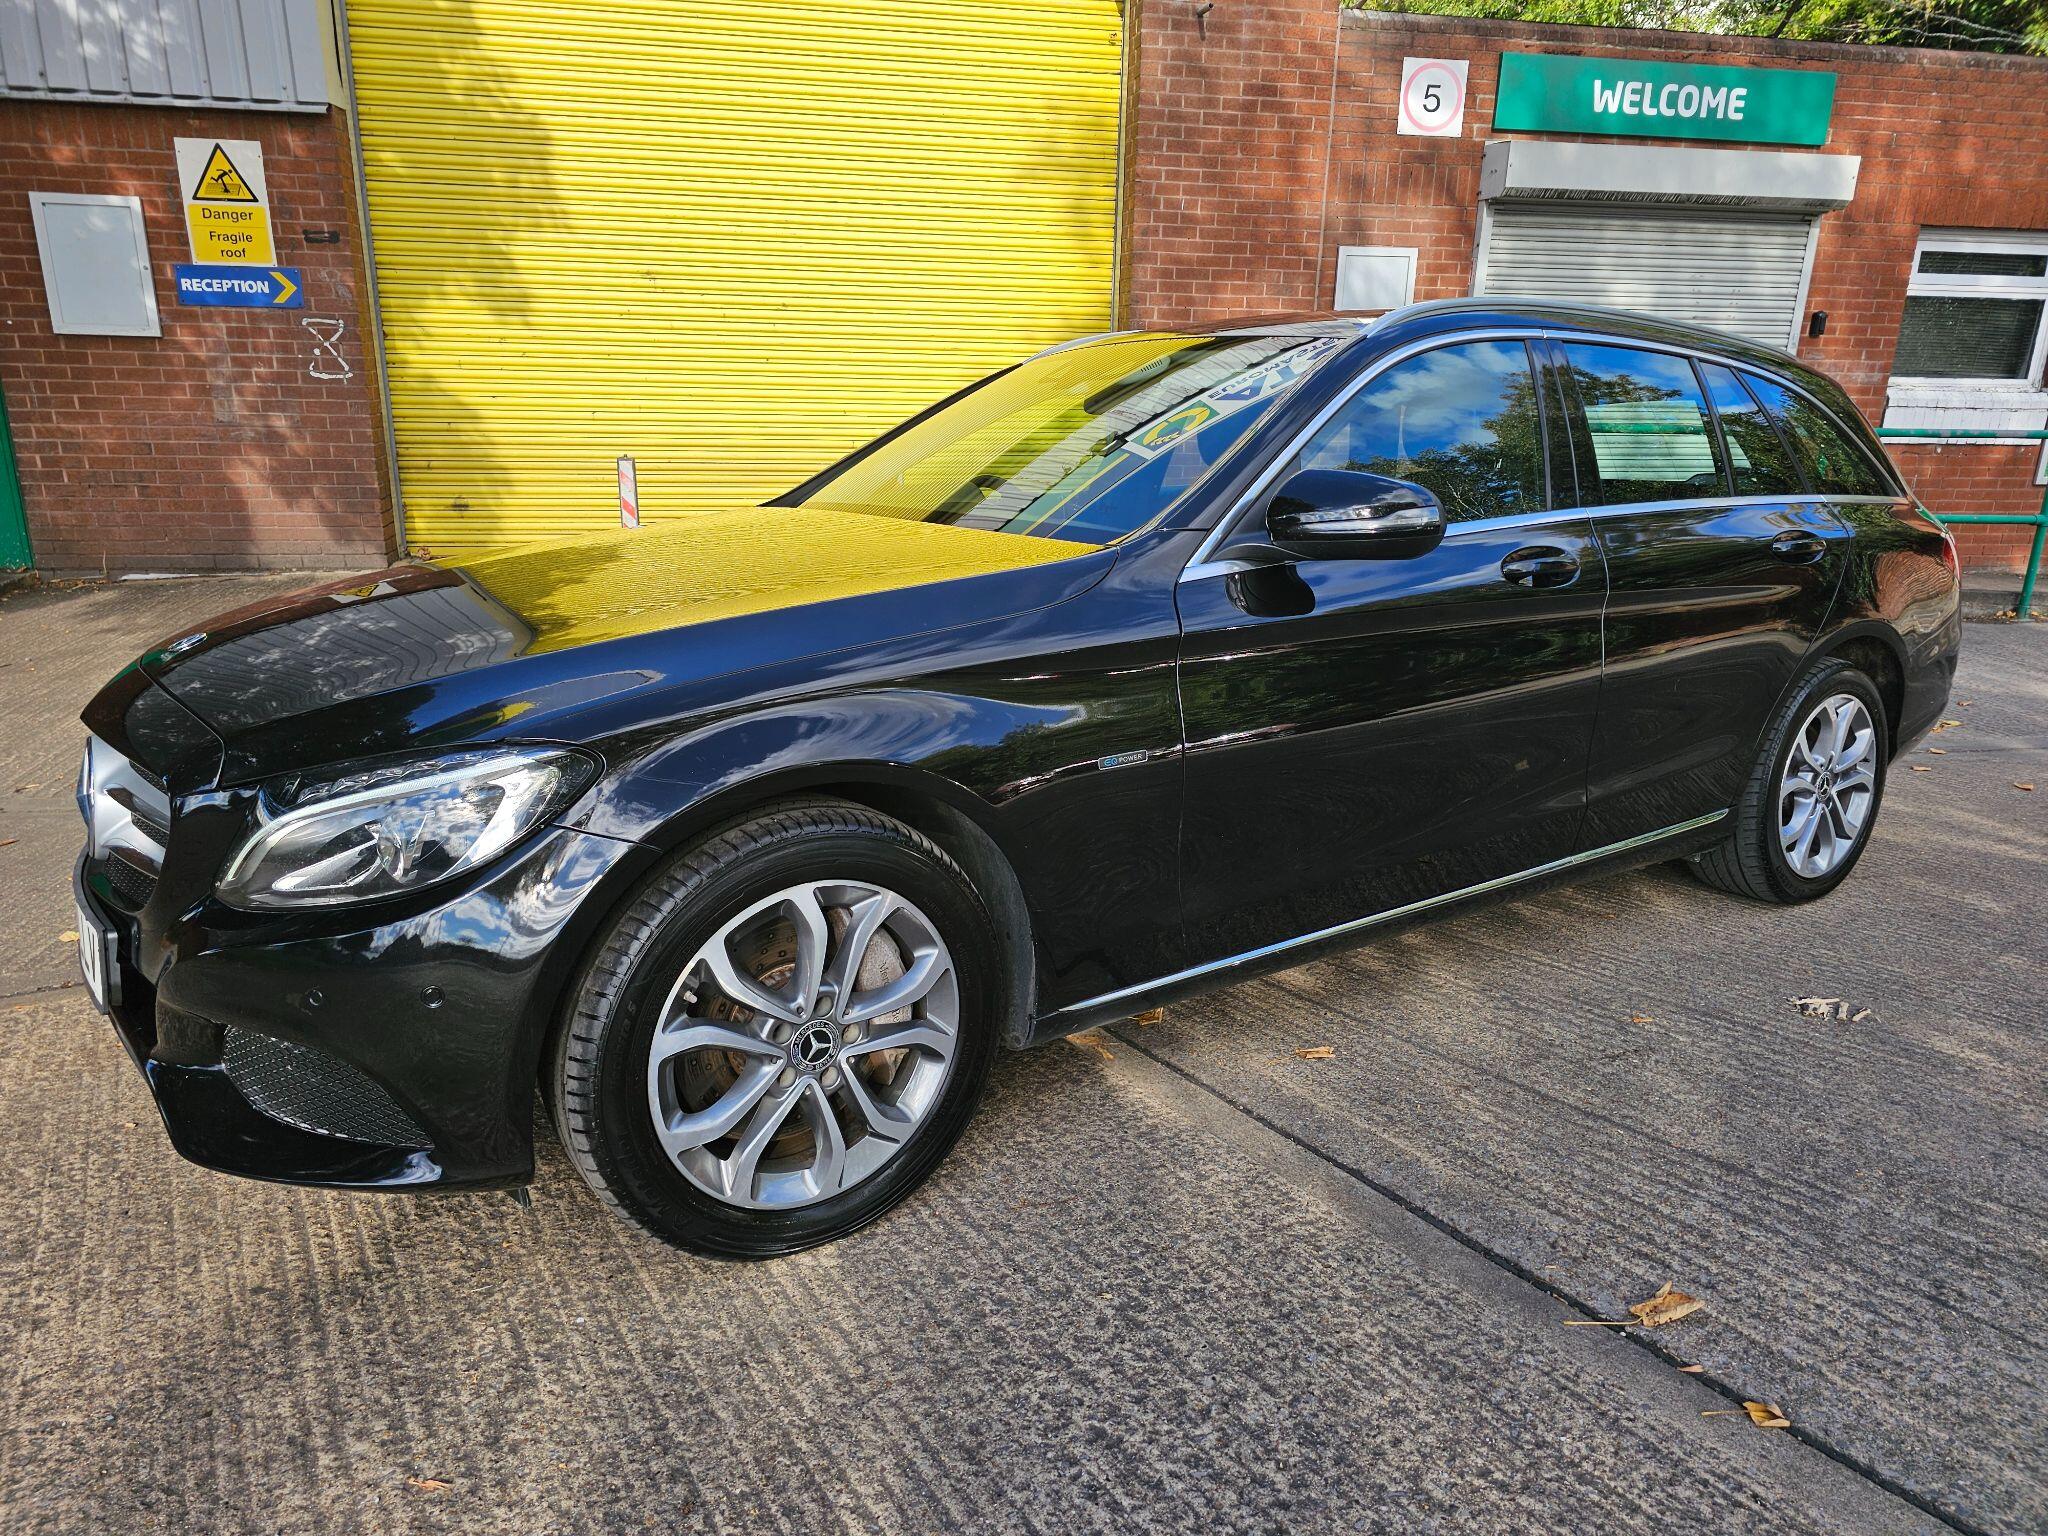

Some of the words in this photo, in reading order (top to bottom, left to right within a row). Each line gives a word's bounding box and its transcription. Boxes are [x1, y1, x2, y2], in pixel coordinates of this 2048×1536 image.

[1422, 84, 1442, 113] 5
[1593, 79, 1748, 120] WELCOME
[201, 207, 254, 223] Danger
[209, 230, 253, 245] Fragile
[221, 248, 246, 258] roof
[180, 278, 270, 294] RECEPTION
[1118, 753, 1142, 763] POWER
[794, 1021, 825, 1044] MERCEDES
